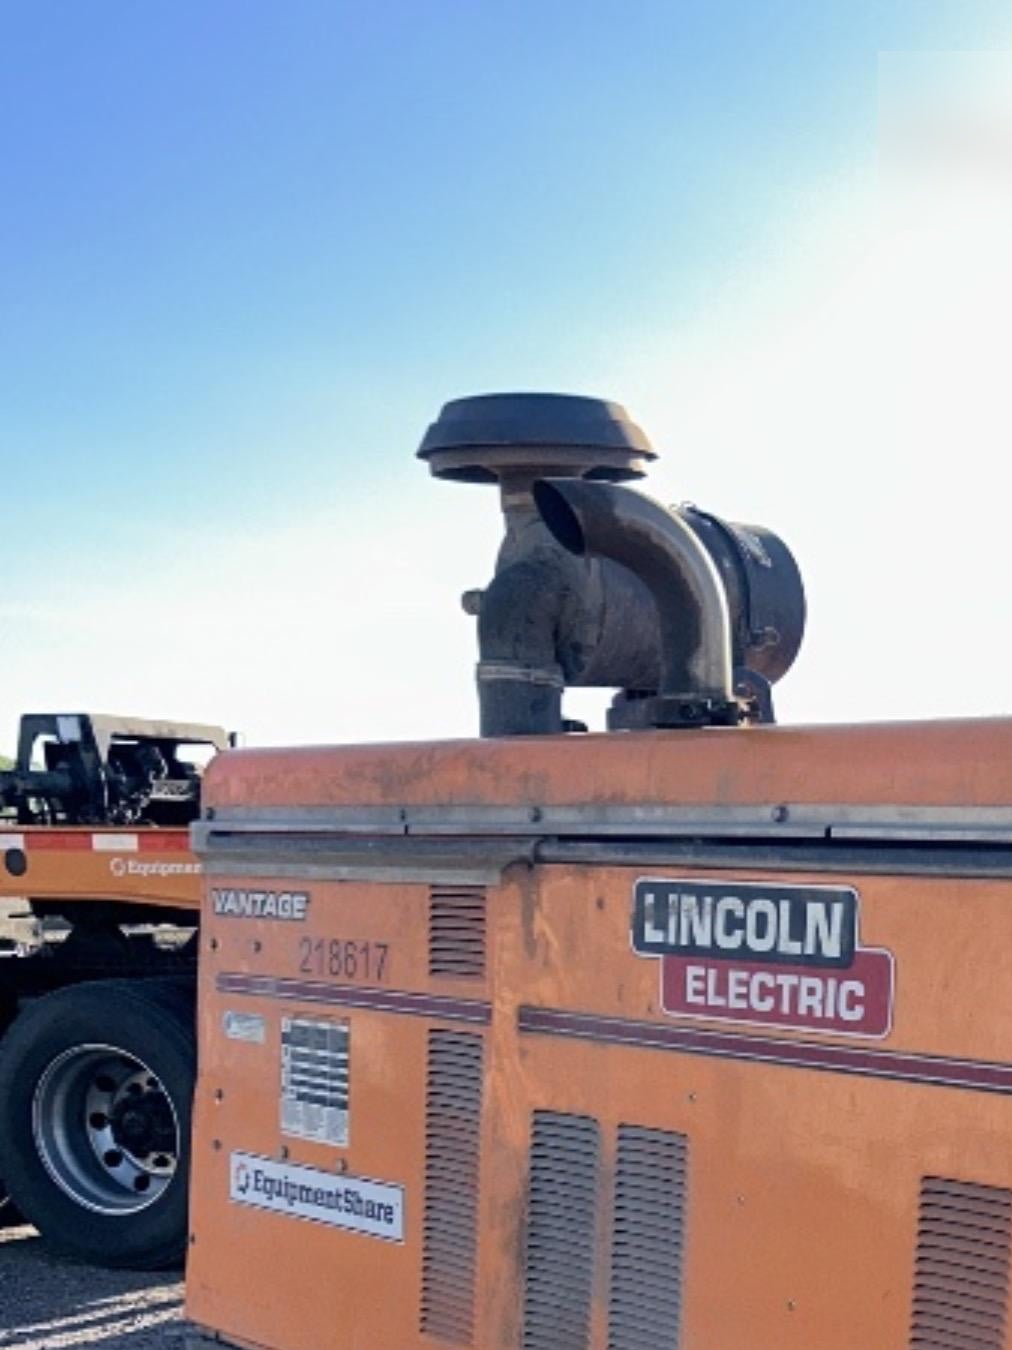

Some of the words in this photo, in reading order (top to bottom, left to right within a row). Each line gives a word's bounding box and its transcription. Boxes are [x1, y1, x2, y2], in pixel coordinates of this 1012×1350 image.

[211, 888, 309, 920] VANTAGE
[643, 893, 845, 958] LINCOLN
[300, 936, 389, 980] 218617
[685, 965, 865, 1022] ELECTRIC
[253, 1169, 395, 1225] EquipmentShare
